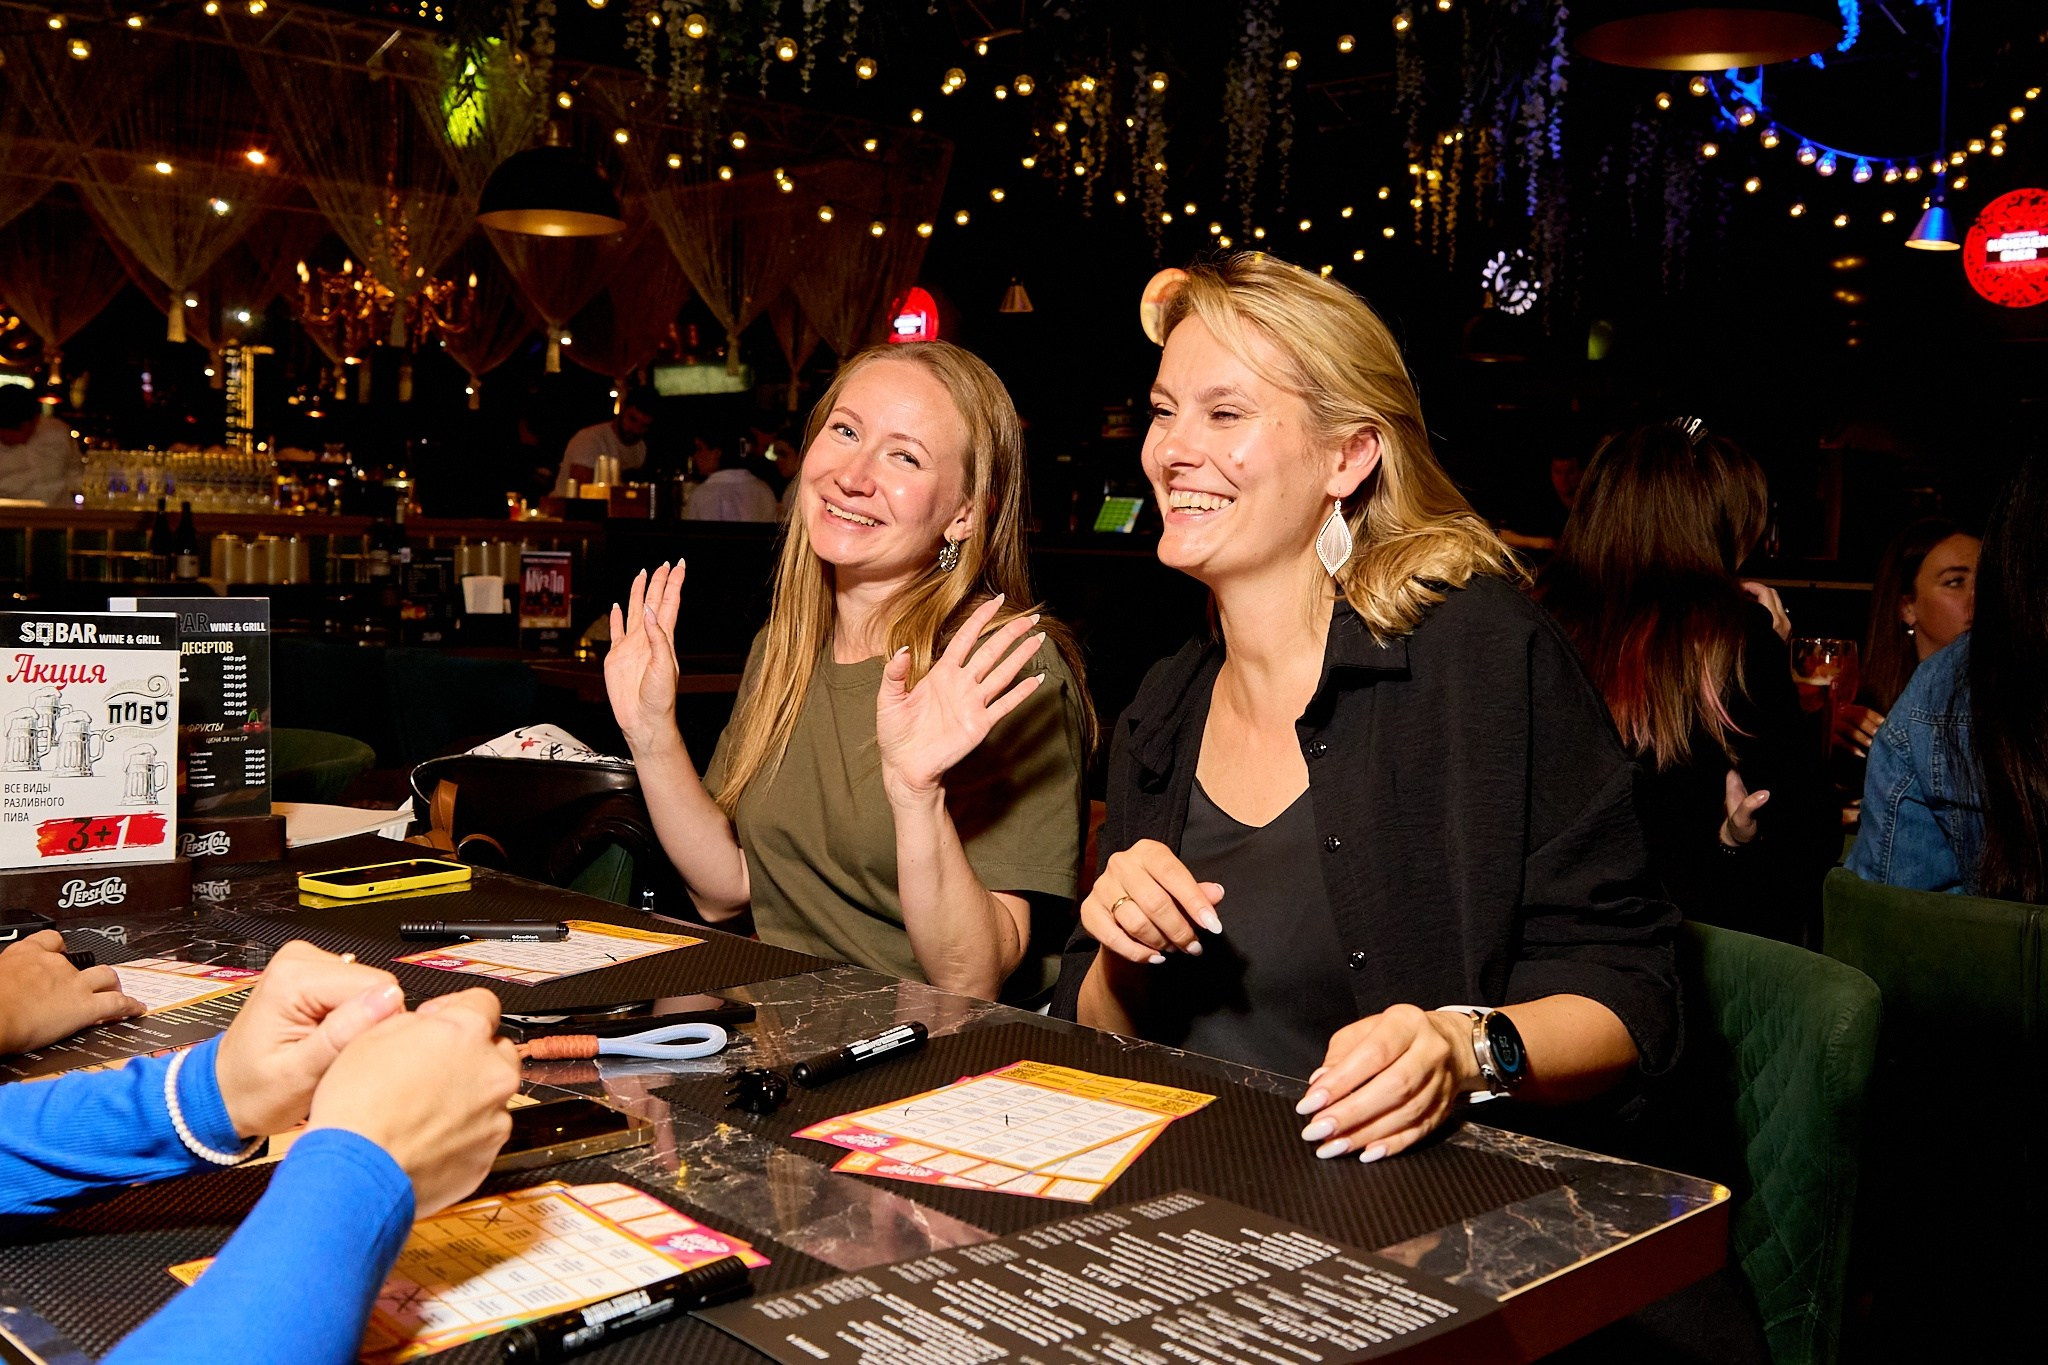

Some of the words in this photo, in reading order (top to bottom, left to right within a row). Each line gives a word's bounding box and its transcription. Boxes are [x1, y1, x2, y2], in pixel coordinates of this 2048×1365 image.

[210, 622, 233, 632] WINE
[234, 623, 242, 632] &
[243, 622, 266, 632] GRILL
[99, 634, 125, 644] WINE
[126, 635, 134, 644] &
[136, 634, 161, 645] GRILL
[180, 641, 234, 656] ДЕСЕРТОВ
[6, 653, 107, 690] Акция
[187, 723, 224, 732] ФРУКТЫ
[4, 784, 21, 794] ВСЕ
[23, 783, 51, 794] ВИДЫ
[4, 797, 65, 808] РАЗЛИВНОГО
[3, 812, 30, 823] ПИВА
